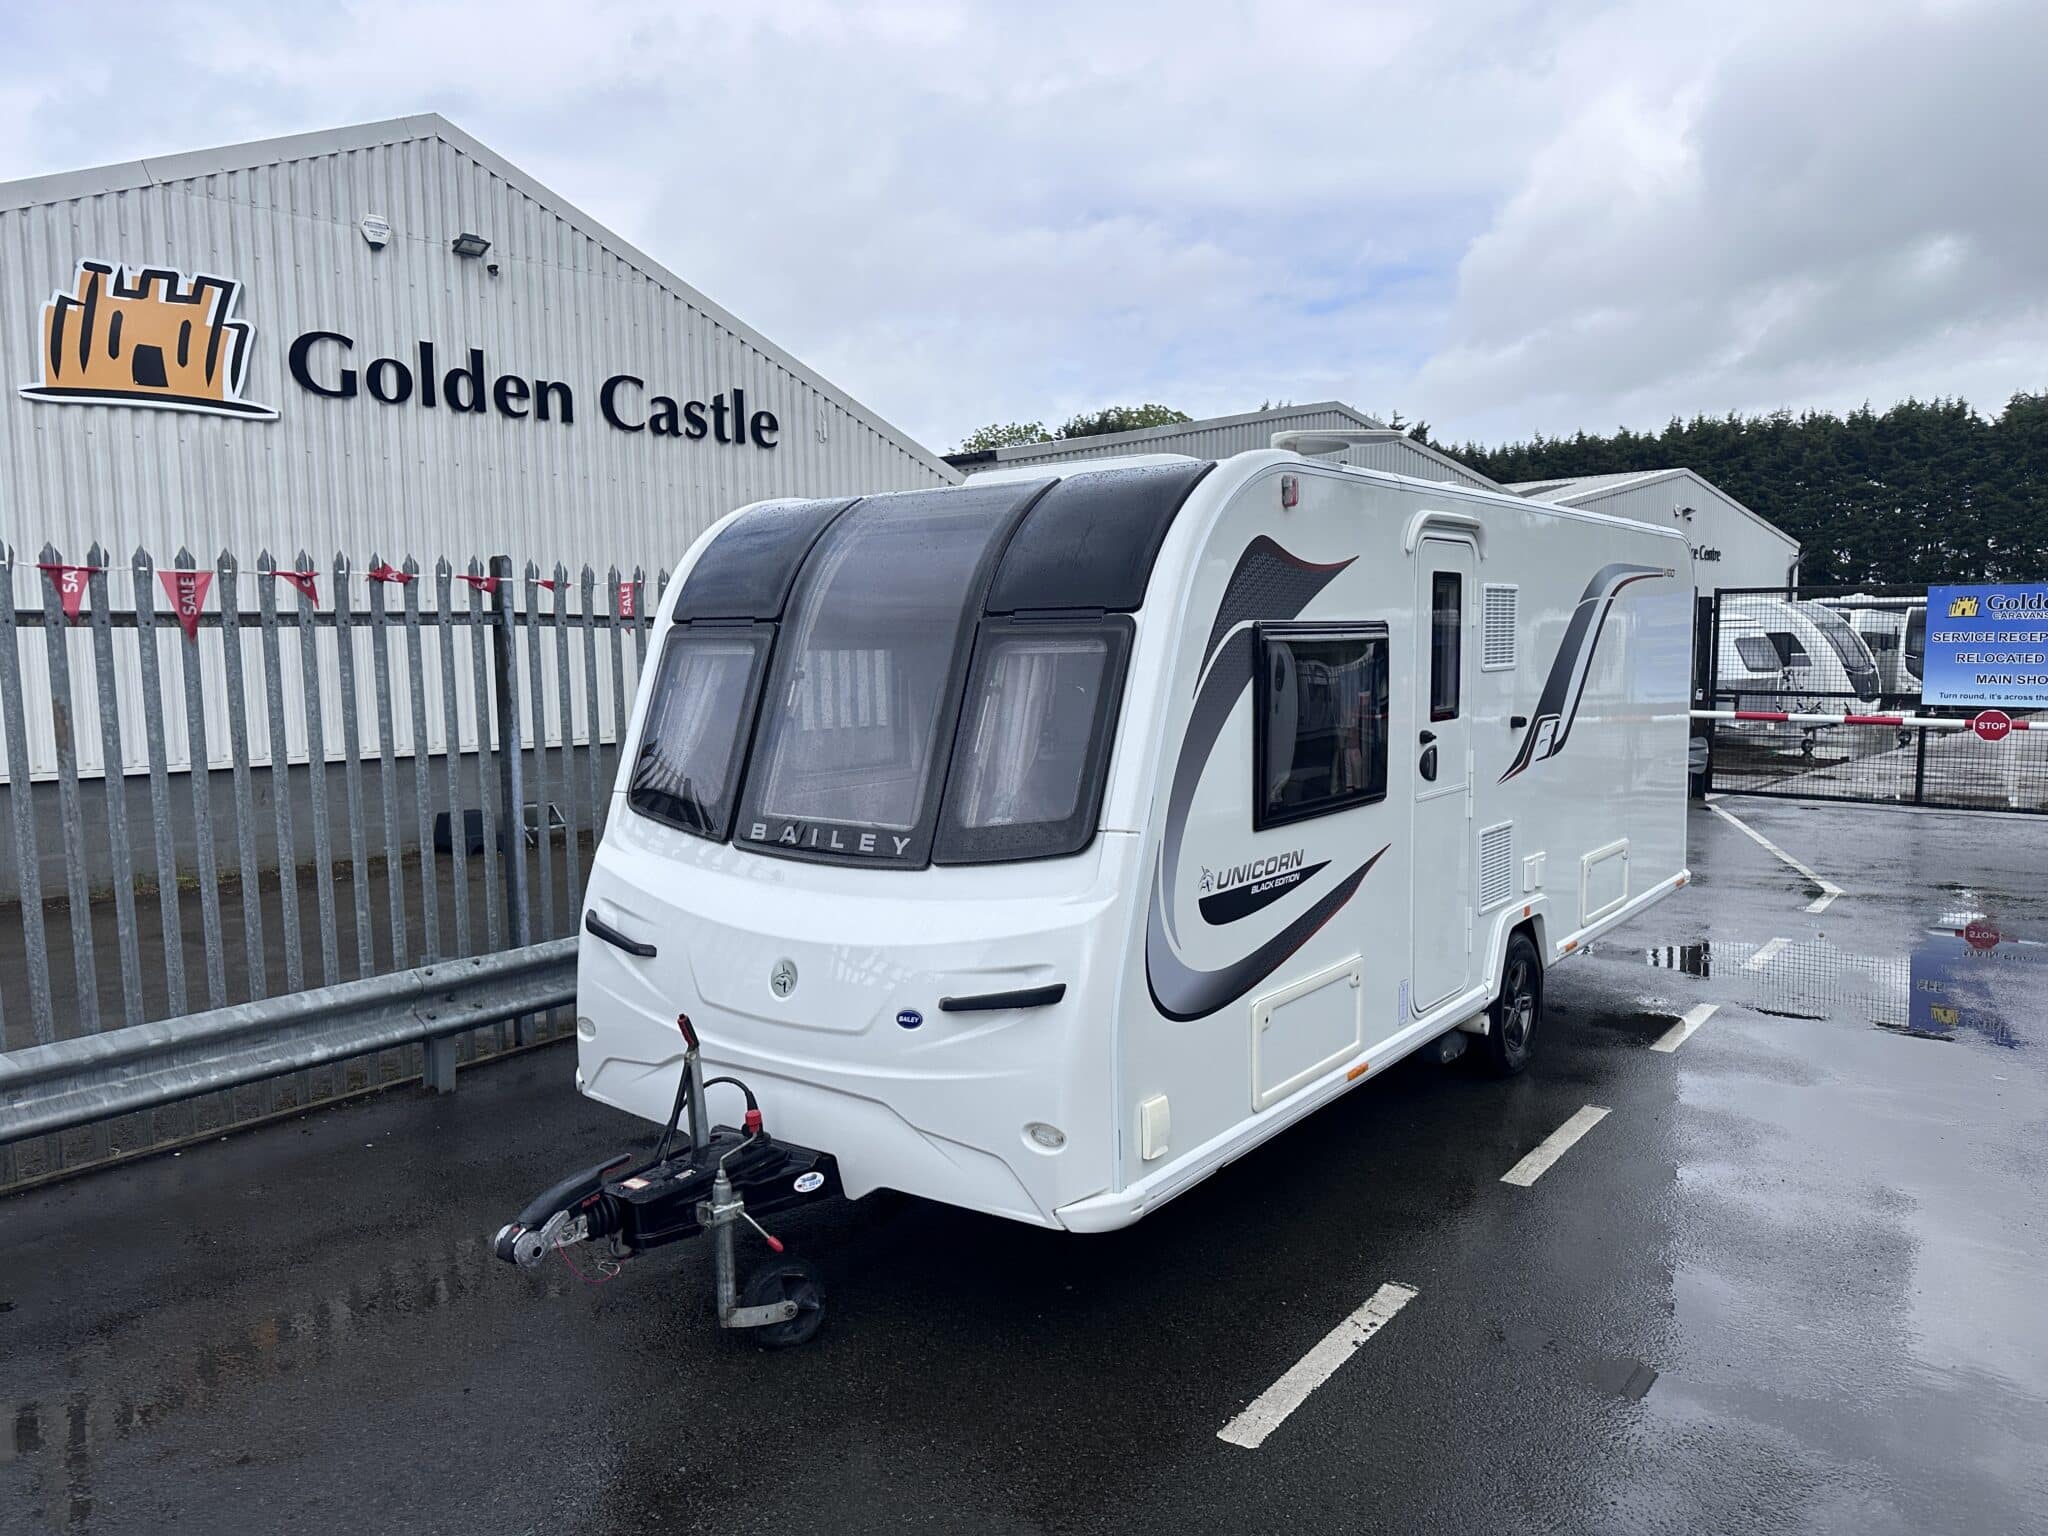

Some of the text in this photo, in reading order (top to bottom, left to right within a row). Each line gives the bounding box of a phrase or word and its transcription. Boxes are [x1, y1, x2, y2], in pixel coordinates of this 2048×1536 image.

[288, 330, 779, 448] Golden Castle
[1699, 544, 1721, 561] Centre
[63, 566, 78, 593] SA
[180, 576, 197, 615] SALE
[623, 585, 632, 615] SALE
[1932, 631, 2048, 643] SERVICE RECEP
[1955, 652, 2045, 664] RELOCATED
[1976, 673, 2048, 685] MAIN SHO
[1939, 691, 1957, 700] Turn
[1989, 692, 2002, 701] it's
[2004, 693, 2033, 702] across
[1978, 721, 2007, 730] STOP
[750, 822, 911, 855] BAILEY
[1216, 848, 1305, 890] UNICORN
[1251, 873, 1301, 895] BLACK EDITION
[898, 1015, 920, 1023] BAILEY
